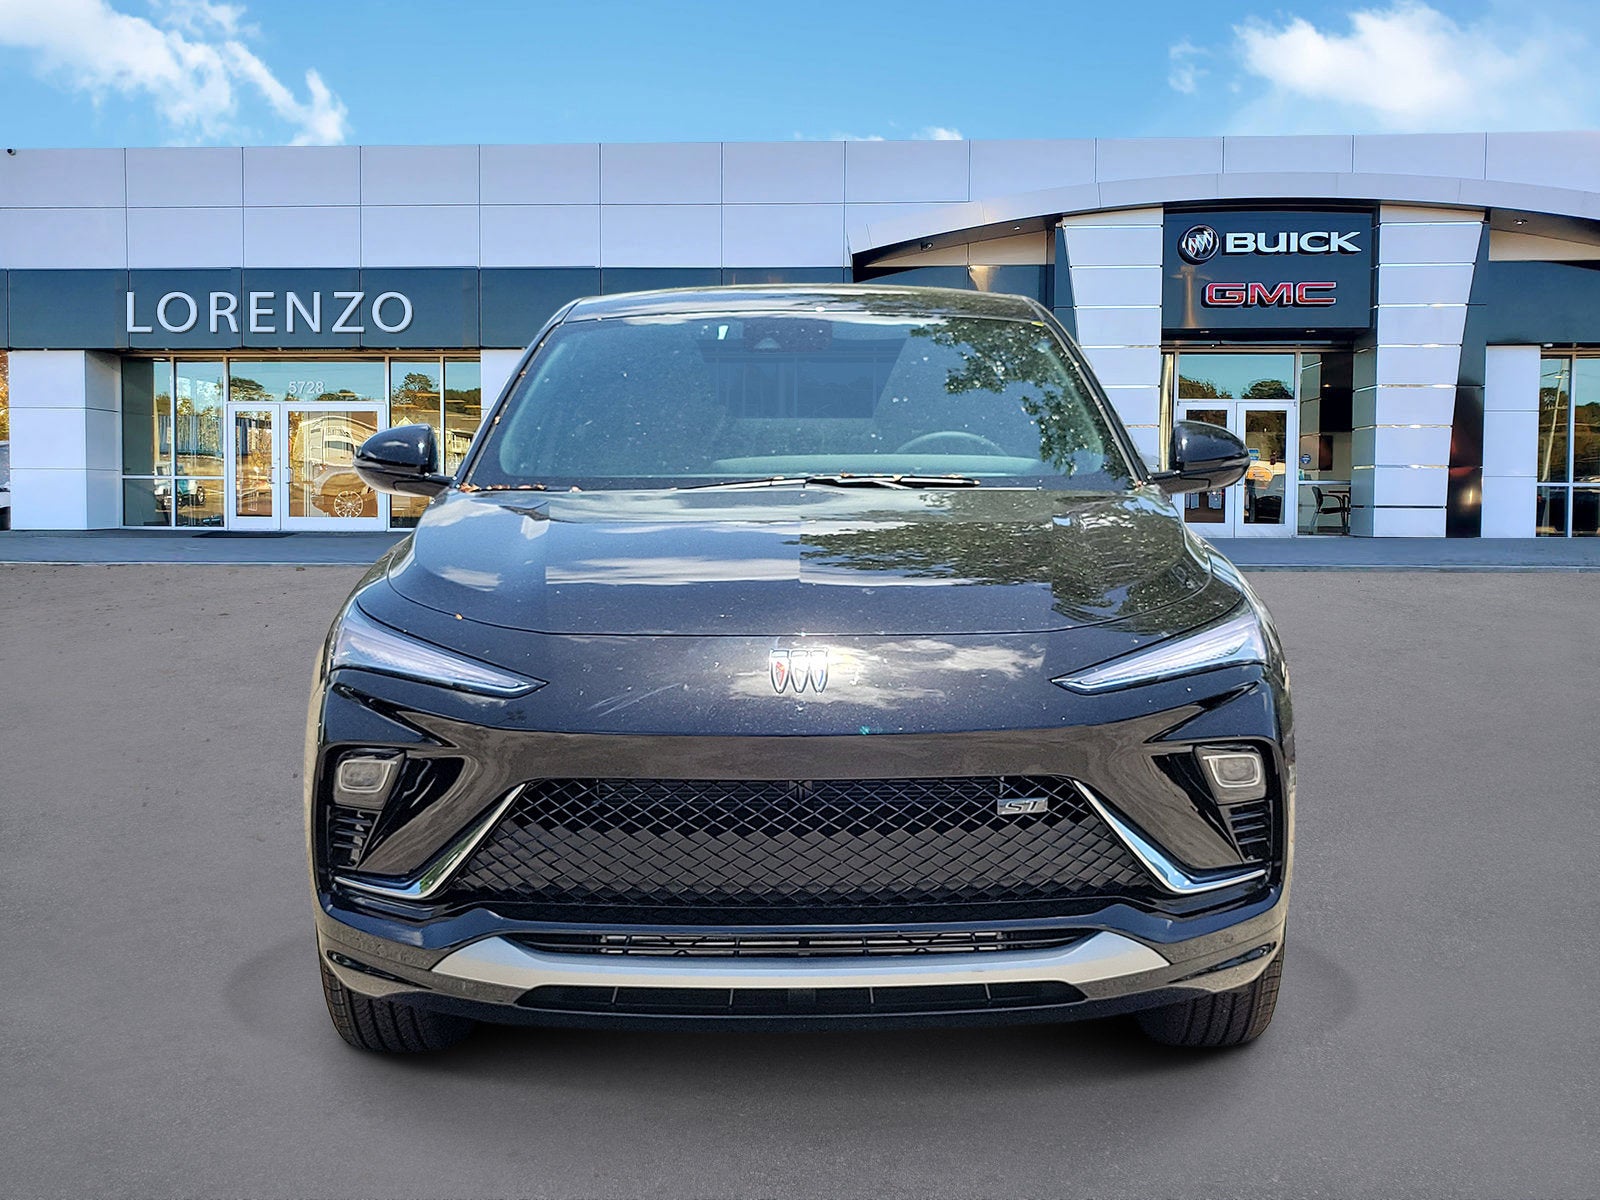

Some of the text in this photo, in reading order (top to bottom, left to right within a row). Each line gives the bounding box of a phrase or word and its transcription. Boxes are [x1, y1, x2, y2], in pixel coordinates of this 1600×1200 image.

[1226, 231, 1361, 253] BUICK
[1206, 282, 1337, 305] GMC
[126, 291, 413, 333] LORENZO
[289, 380, 325, 394] 5728
[1004, 799, 1040, 813] ST
